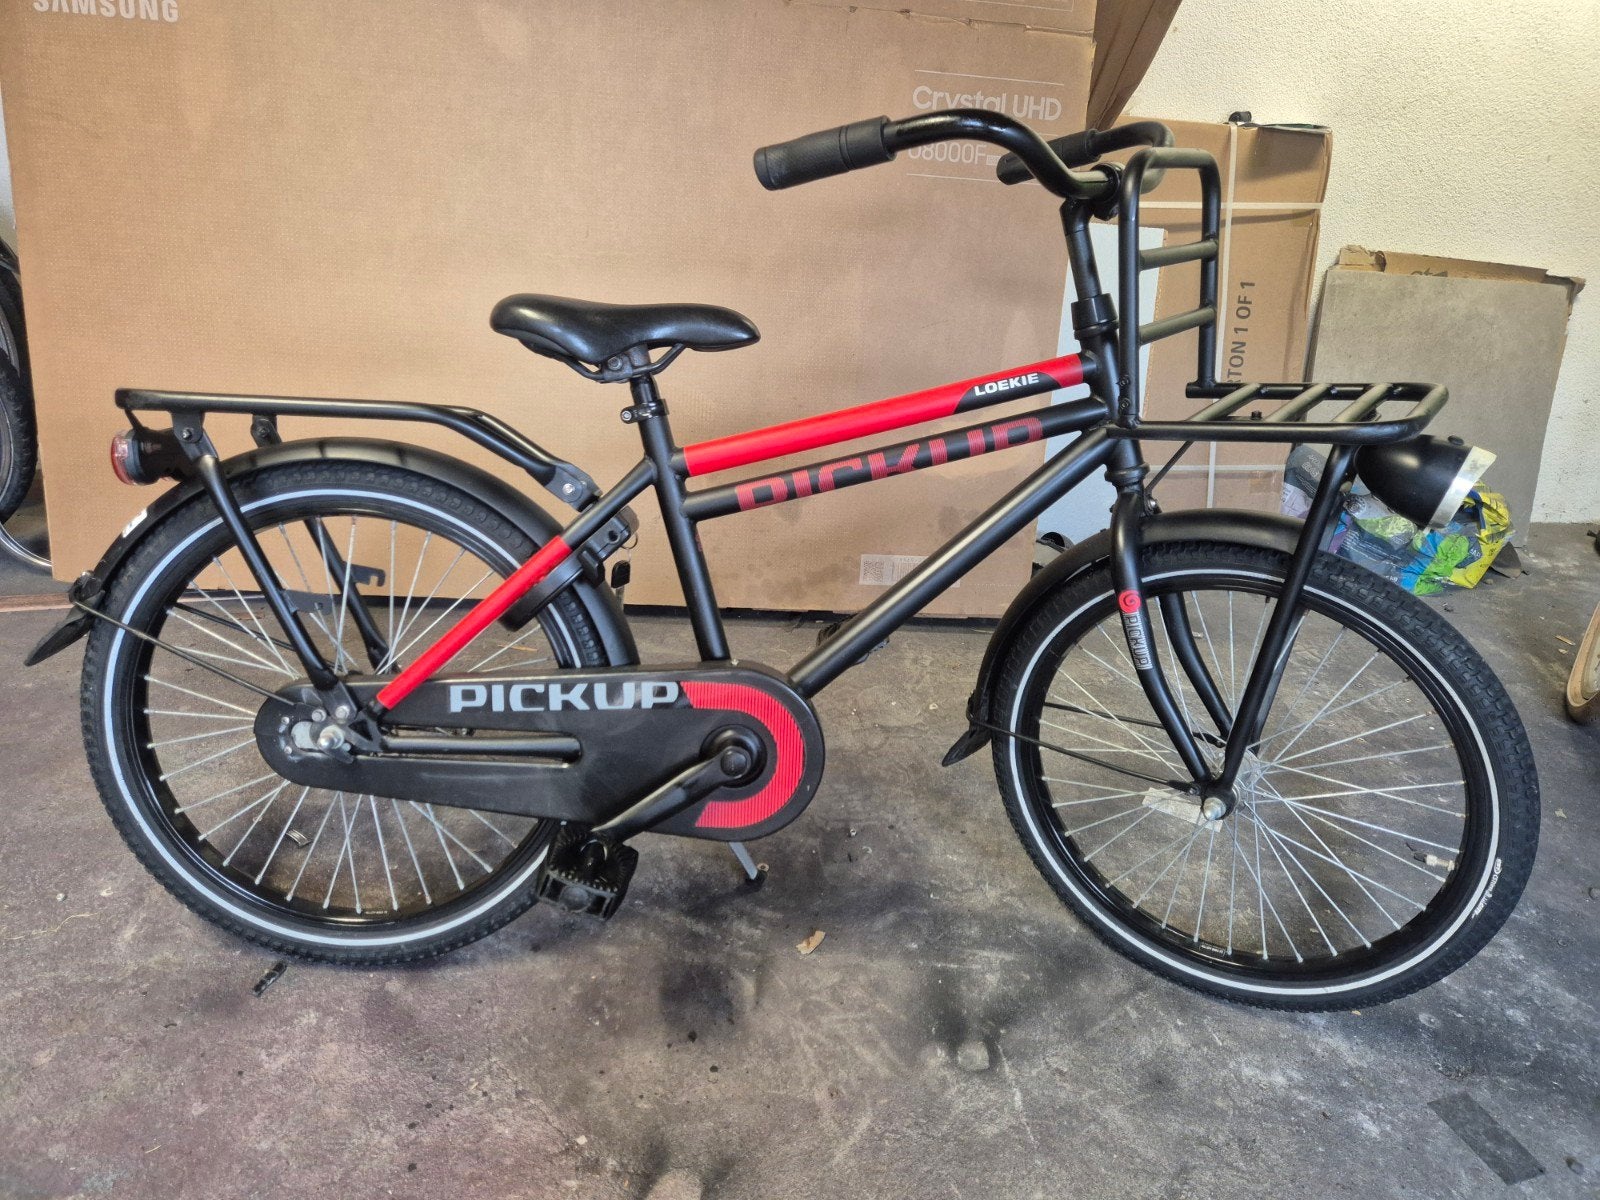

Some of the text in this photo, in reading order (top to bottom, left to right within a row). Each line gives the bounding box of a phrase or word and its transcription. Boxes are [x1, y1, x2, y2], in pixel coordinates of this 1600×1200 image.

[33, 0, 179, 23] SAMSUNG
[912, 85, 1062, 121] Crystal UHD
[1239, 280, 1256, 289] 1
[1235, 295, 1253, 320] OF
[1233, 326, 1249, 335] 1
[974, 372, 1040, 396] LOEKIE
[449, 681, 679, 713] PICKUP
